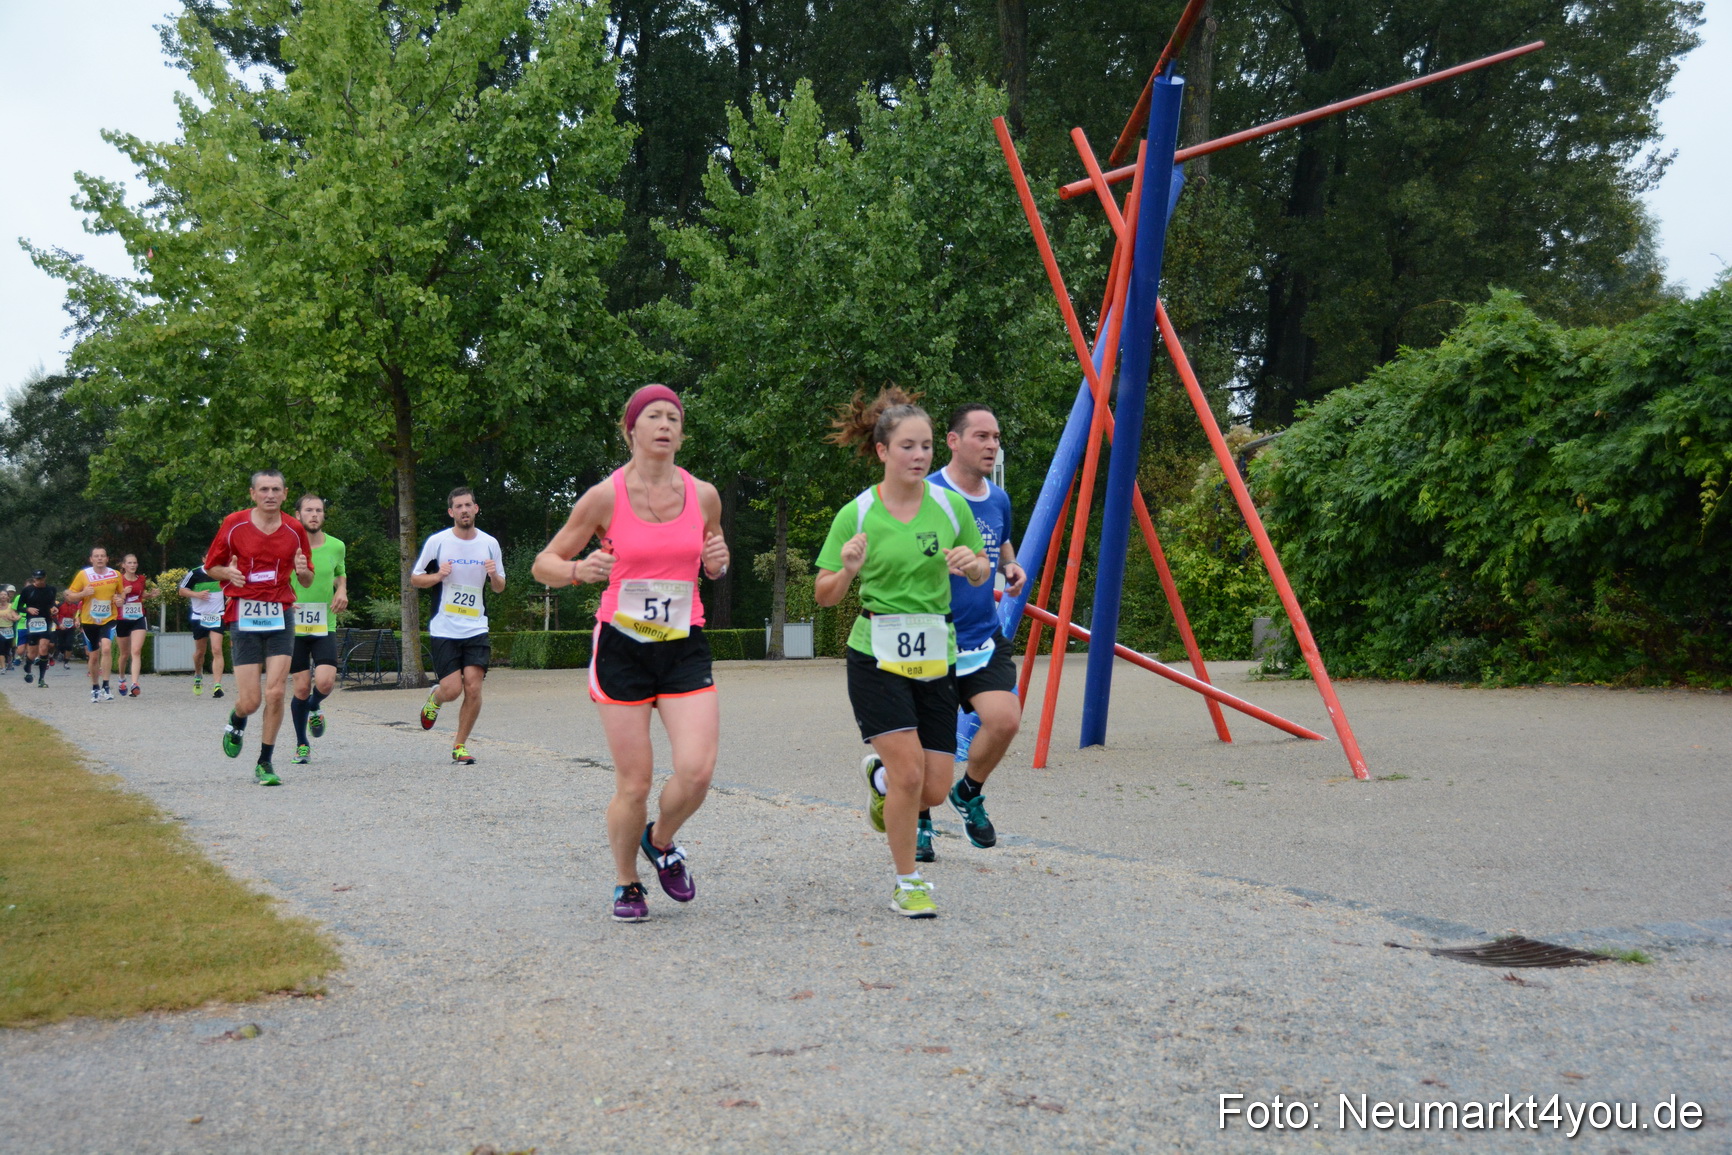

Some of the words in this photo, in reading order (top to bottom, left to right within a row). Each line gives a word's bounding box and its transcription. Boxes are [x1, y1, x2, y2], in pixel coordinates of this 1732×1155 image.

[453, 591, 476, 607] 229
[125, 606, 141, 614] 2324
[244, 601, 280, 617] 2413
[643, 597, 672, 622] 51
[299, 611, 321, 624] 154
[633, 622, 669, 641] Simone
[897, 631, 927, 658] 84
